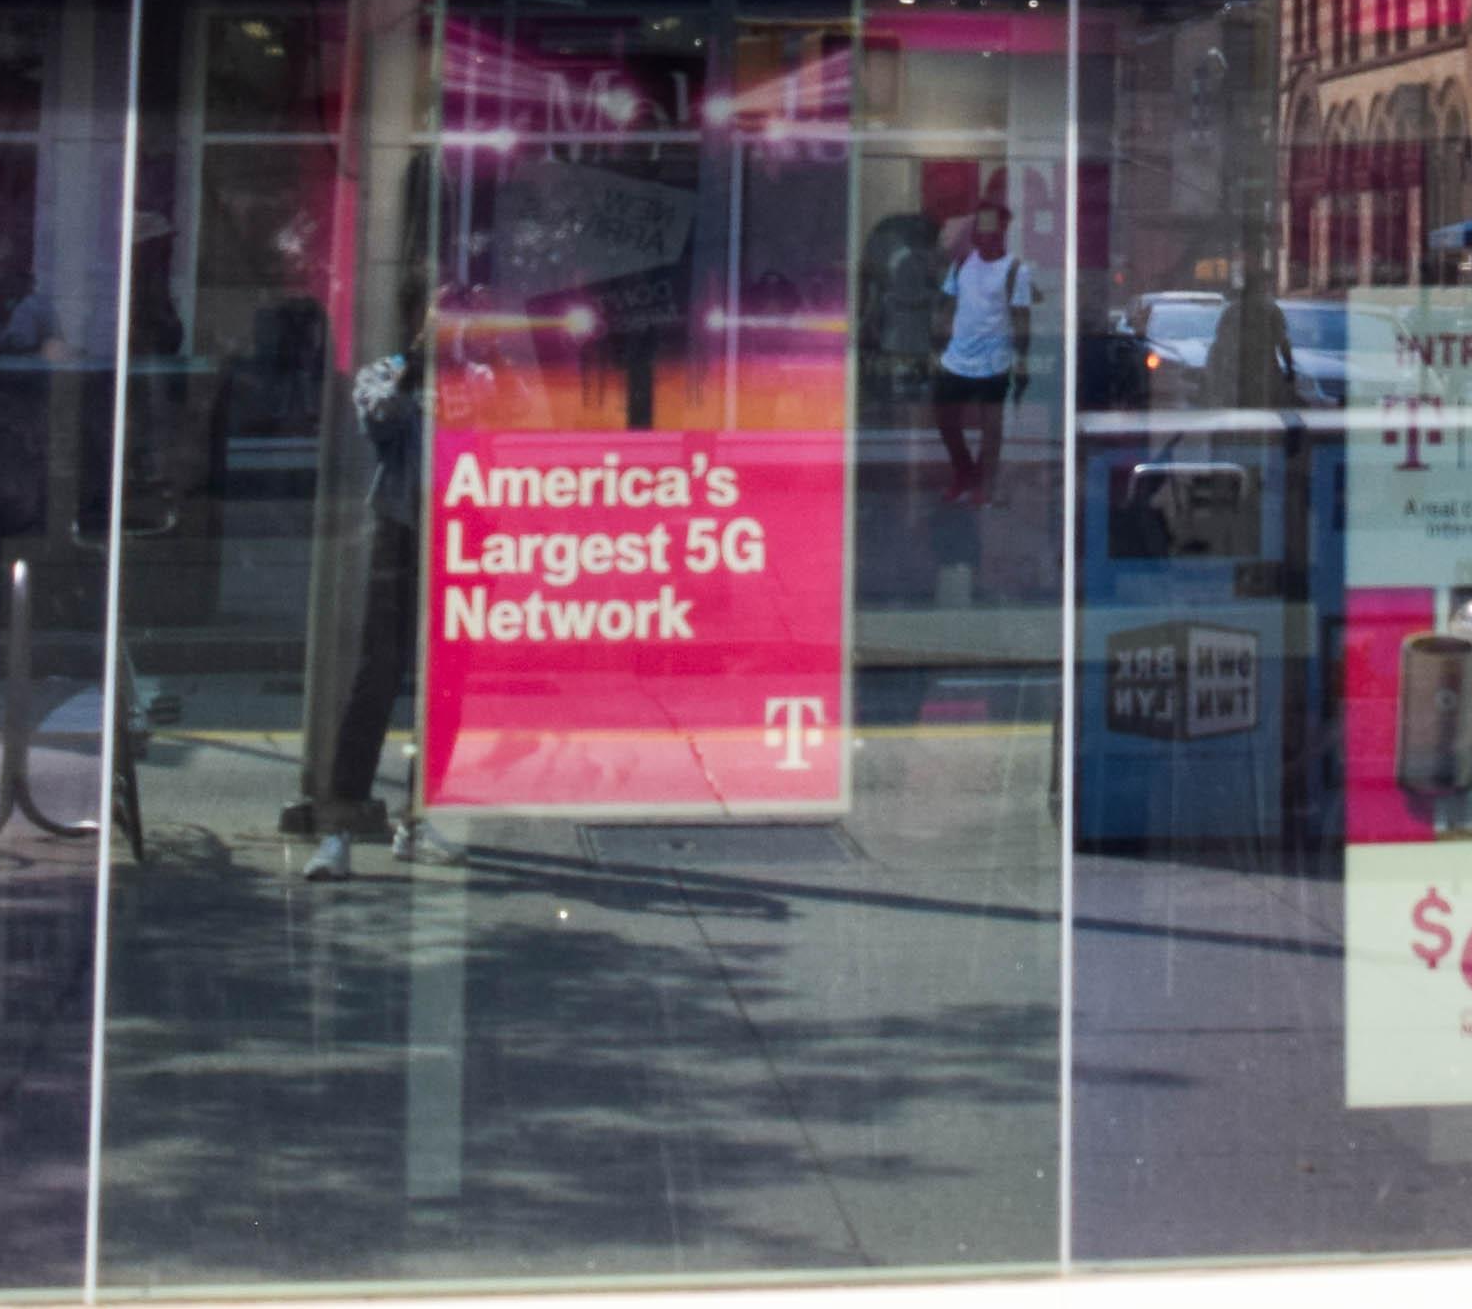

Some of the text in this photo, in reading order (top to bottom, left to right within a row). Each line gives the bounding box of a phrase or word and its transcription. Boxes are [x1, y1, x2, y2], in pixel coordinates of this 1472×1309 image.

[444, 453, 738, 510] America's
[446, 519, 766, 591] Largest 5G
[445, 586, 695, 641] Network
